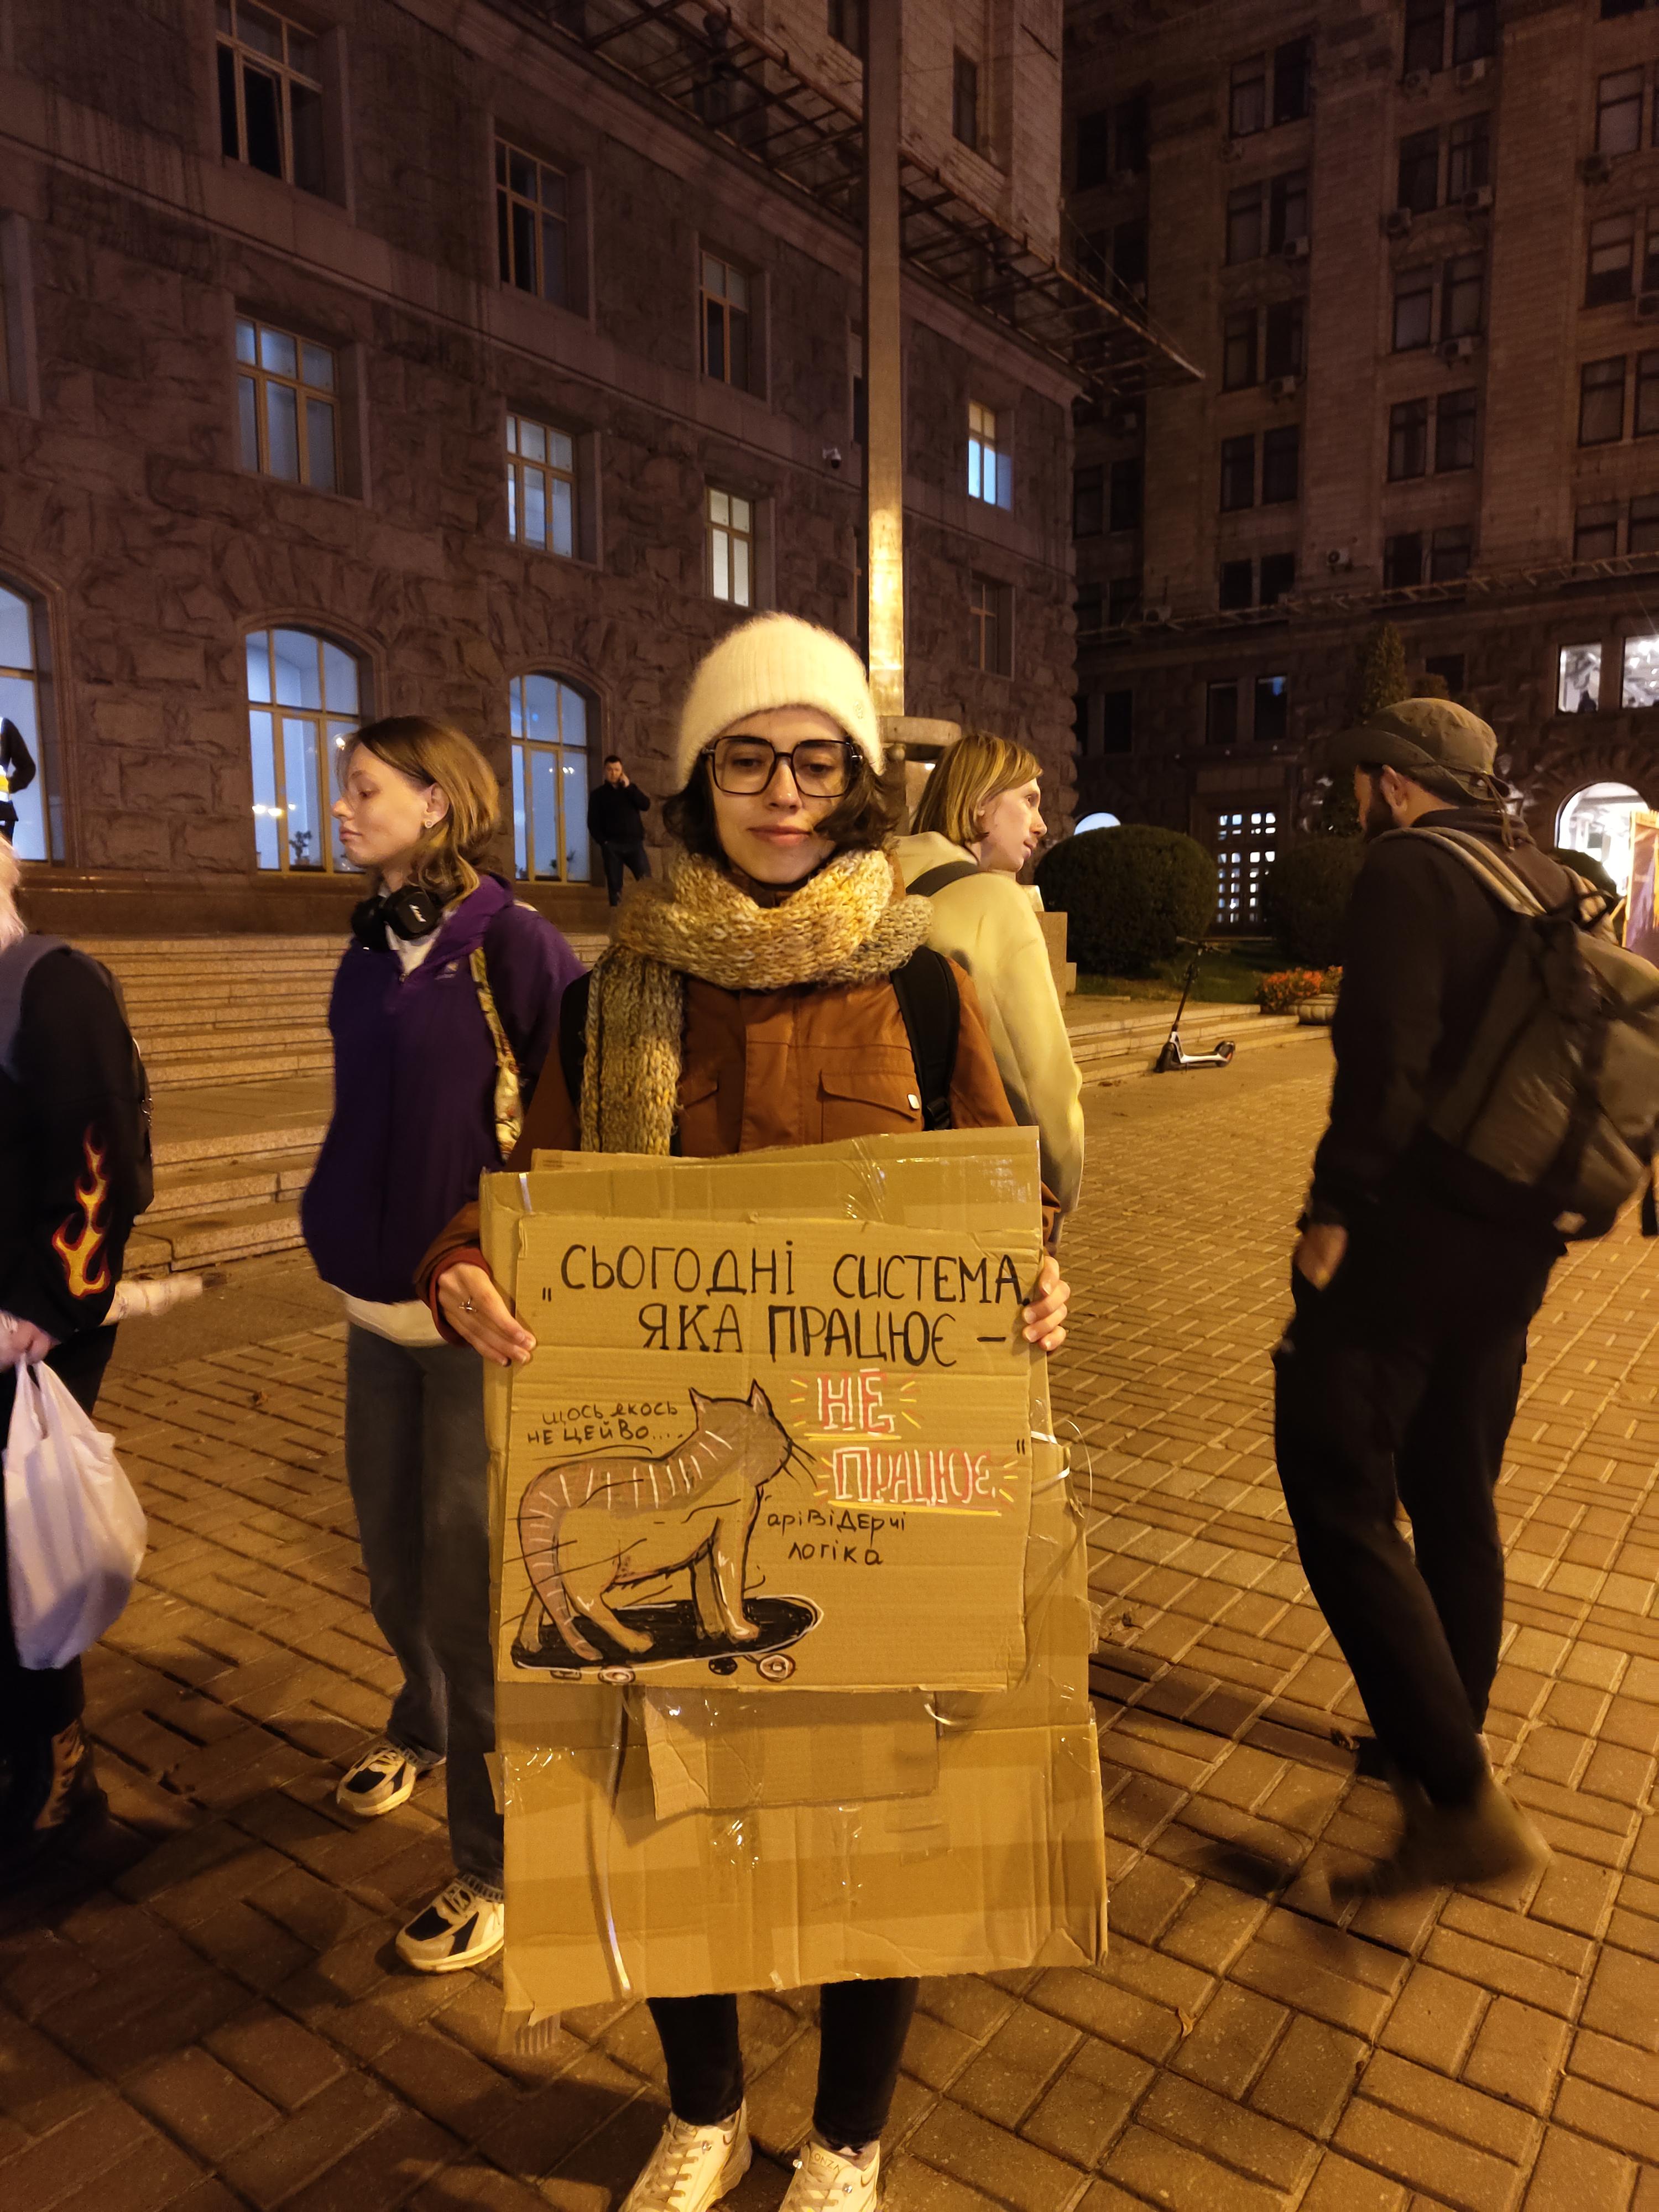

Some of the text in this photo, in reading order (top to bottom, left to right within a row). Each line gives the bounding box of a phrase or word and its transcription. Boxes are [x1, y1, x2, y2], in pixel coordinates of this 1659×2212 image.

[638, 1302, 743, 1353] ЯКА
[768, 1305, 957, 1367] ПРАЦЮЄ
[817, 1368, 896, 1437] НЕ
[787, 1539, 884, 1566] логіка
